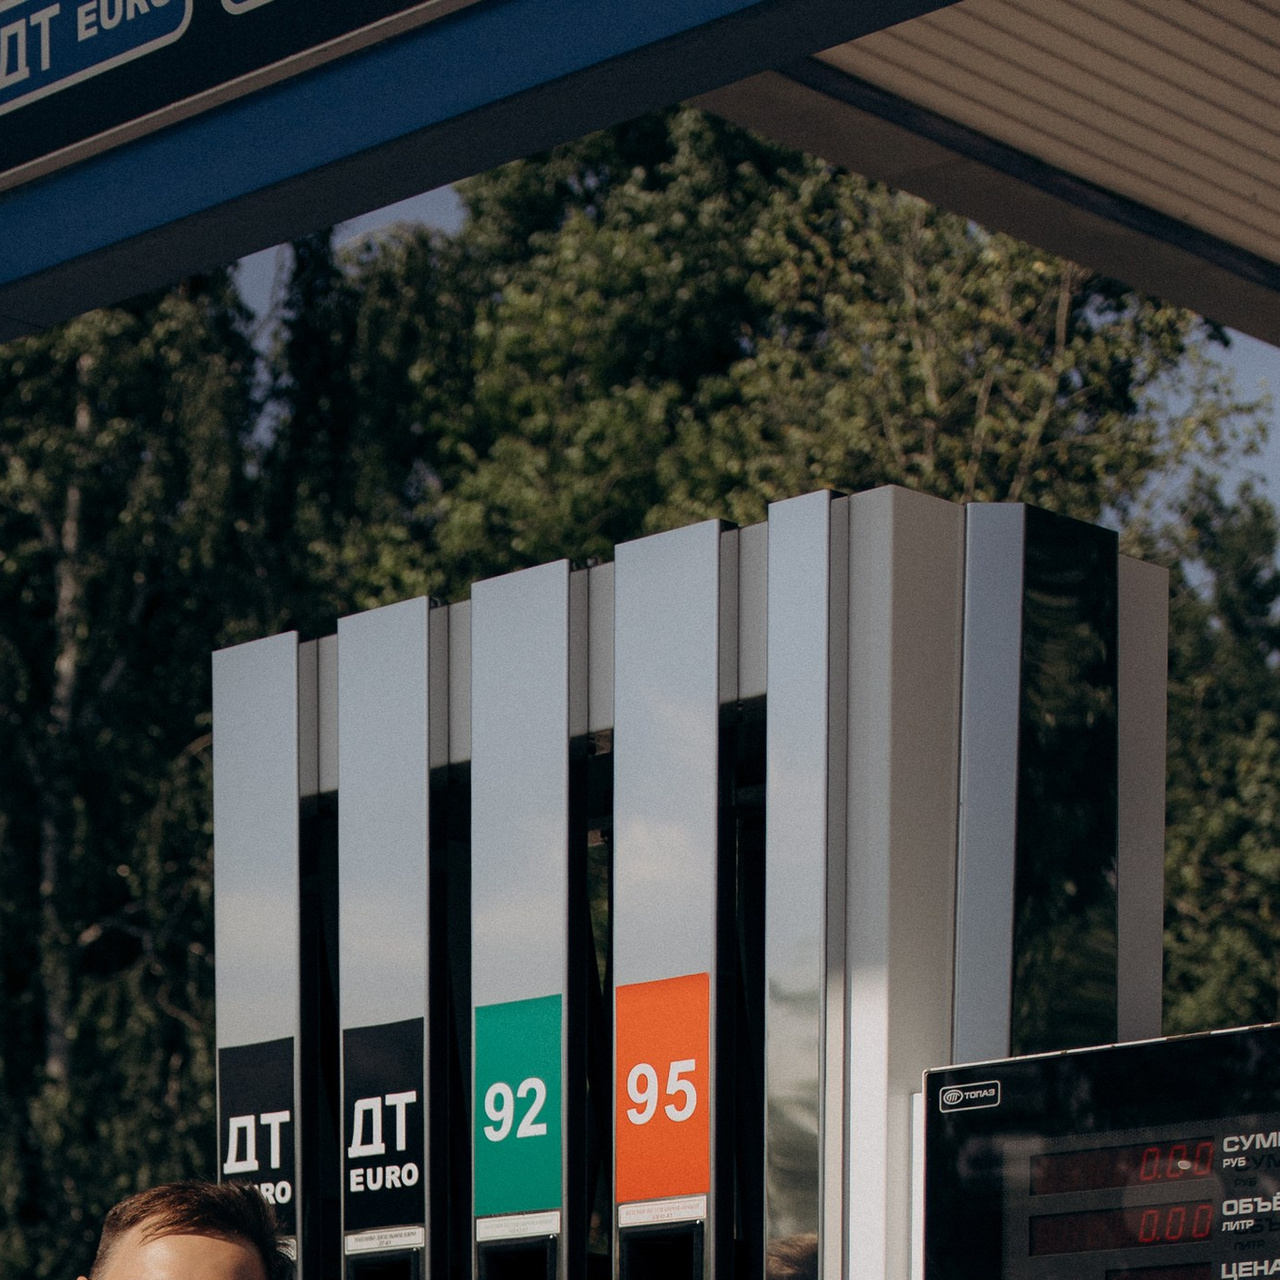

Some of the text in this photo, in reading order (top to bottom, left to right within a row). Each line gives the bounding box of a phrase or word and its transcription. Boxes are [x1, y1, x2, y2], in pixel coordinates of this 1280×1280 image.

[483, 1077, 547, 1142] 92
[626, 1059, 697, 1125] 95
[964, 1088, 996, 1099] ТОПАЗ
[223, 1110, 291, 1174] ДТ
[348, 1091, 417, 1158] ДТ
[350, 1162, 419, 1192] EURO
[1140, 1142, 1214, 1181] 0.00
[1222, 1156, 1246, 1168] РУБ
[1138, 1204, 1213, 1243] 0.00
[1221, 1219, 1255, 1232] ЛИТР
[1221, 1258, 1280, 1280] ЦЕНА
